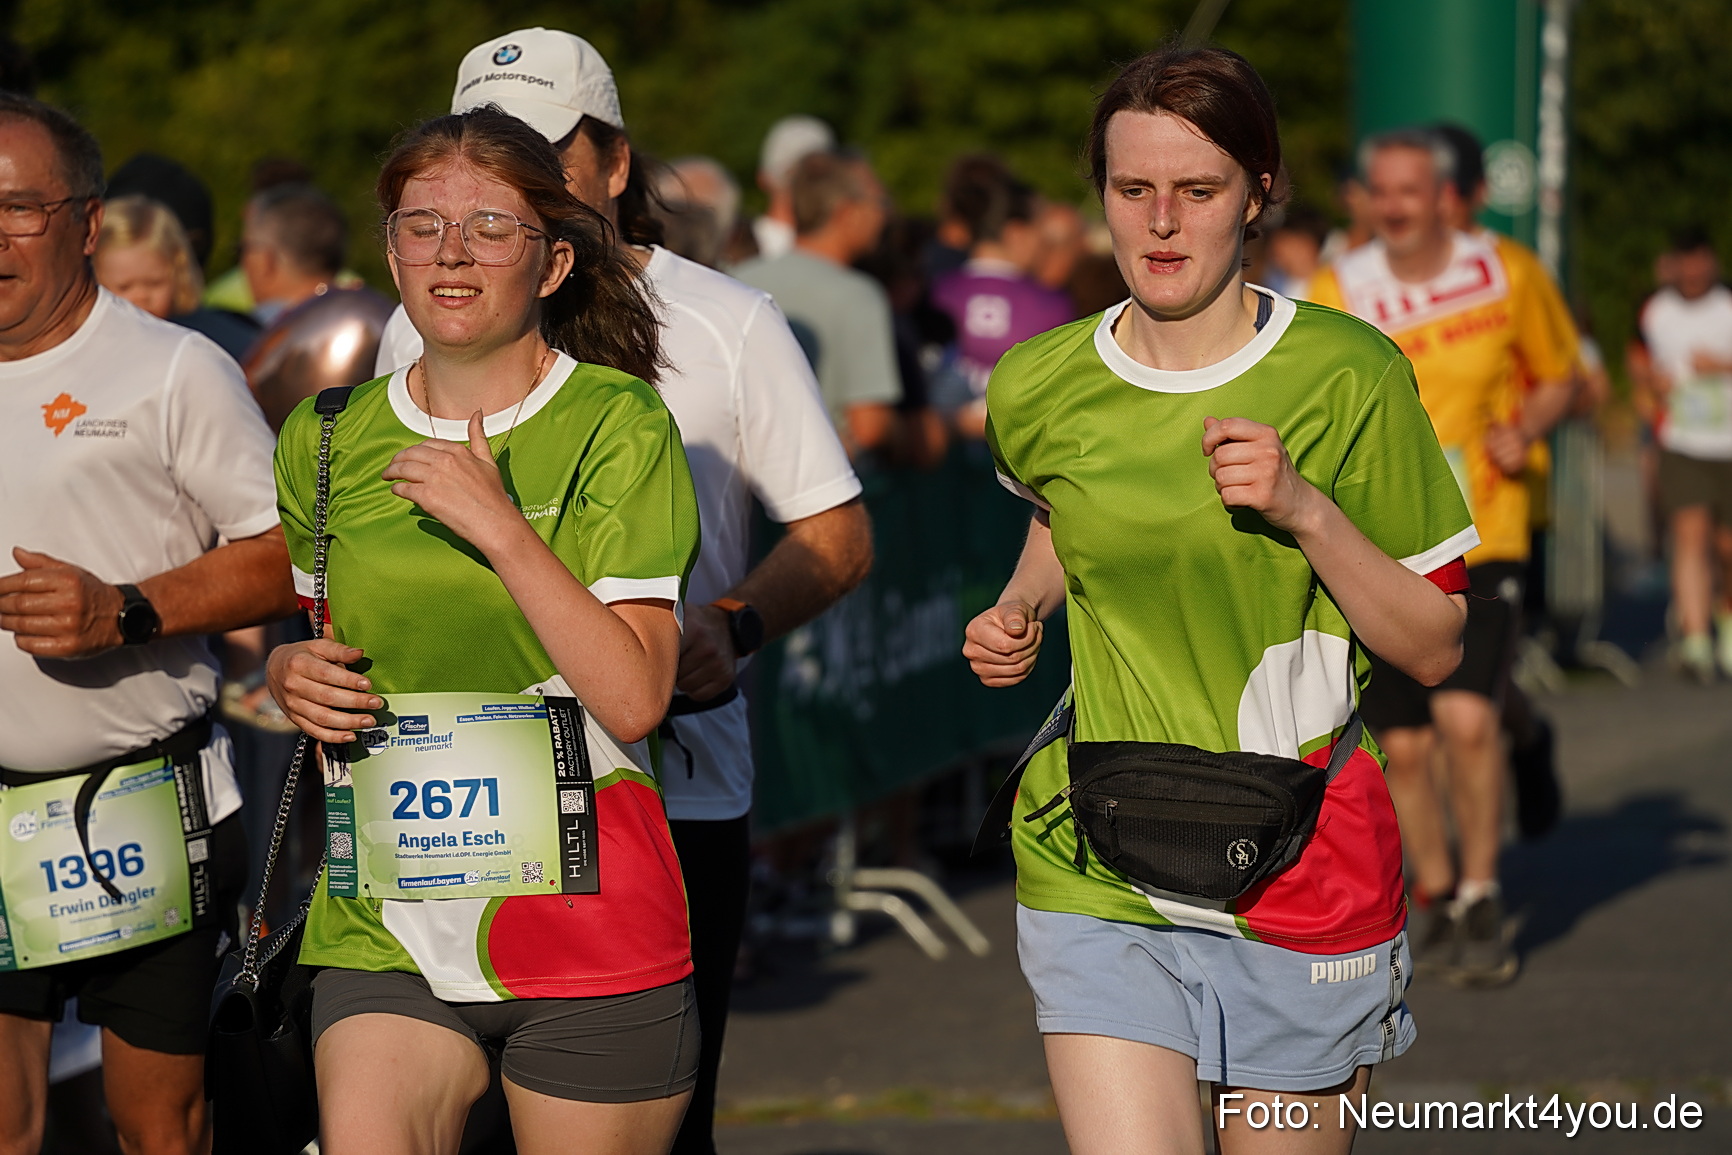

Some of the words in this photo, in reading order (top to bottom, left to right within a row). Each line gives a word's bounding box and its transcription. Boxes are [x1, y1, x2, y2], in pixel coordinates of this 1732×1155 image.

[483, 72, 555, 90] Motorsport
[74, 429, 126, 438] NEUMARKT
[548, 706, 563, 749] RABATT
[558, 707, 572, 739] OUTLET
[391, 731, 454, 748] Firmenlauf
[415, 742, 453, 753] neumarkt
[556, 751, 564, 760] %
[565, 739, 576, 777] FACTORY
[557, 761, 567, 778] 20
[389, 777, 500, 820] 2671
[398, 831, 458, 852] Angela
[462, 829, 506, 846] Esch
[566, 819, 582, 878] HILTL
[39, 842, 146, 893] 1396
[480, 873, 511, 882] Firmenlauf
[193, 864, 206, 916] HILTL
[400, 877, 462, 888] firmenlauf.bayern
[48, 898, 95, 918] Erwin
[1310, 953, 1377, 985] PUMA
[1391, 953, 1401, 981] PUMA
